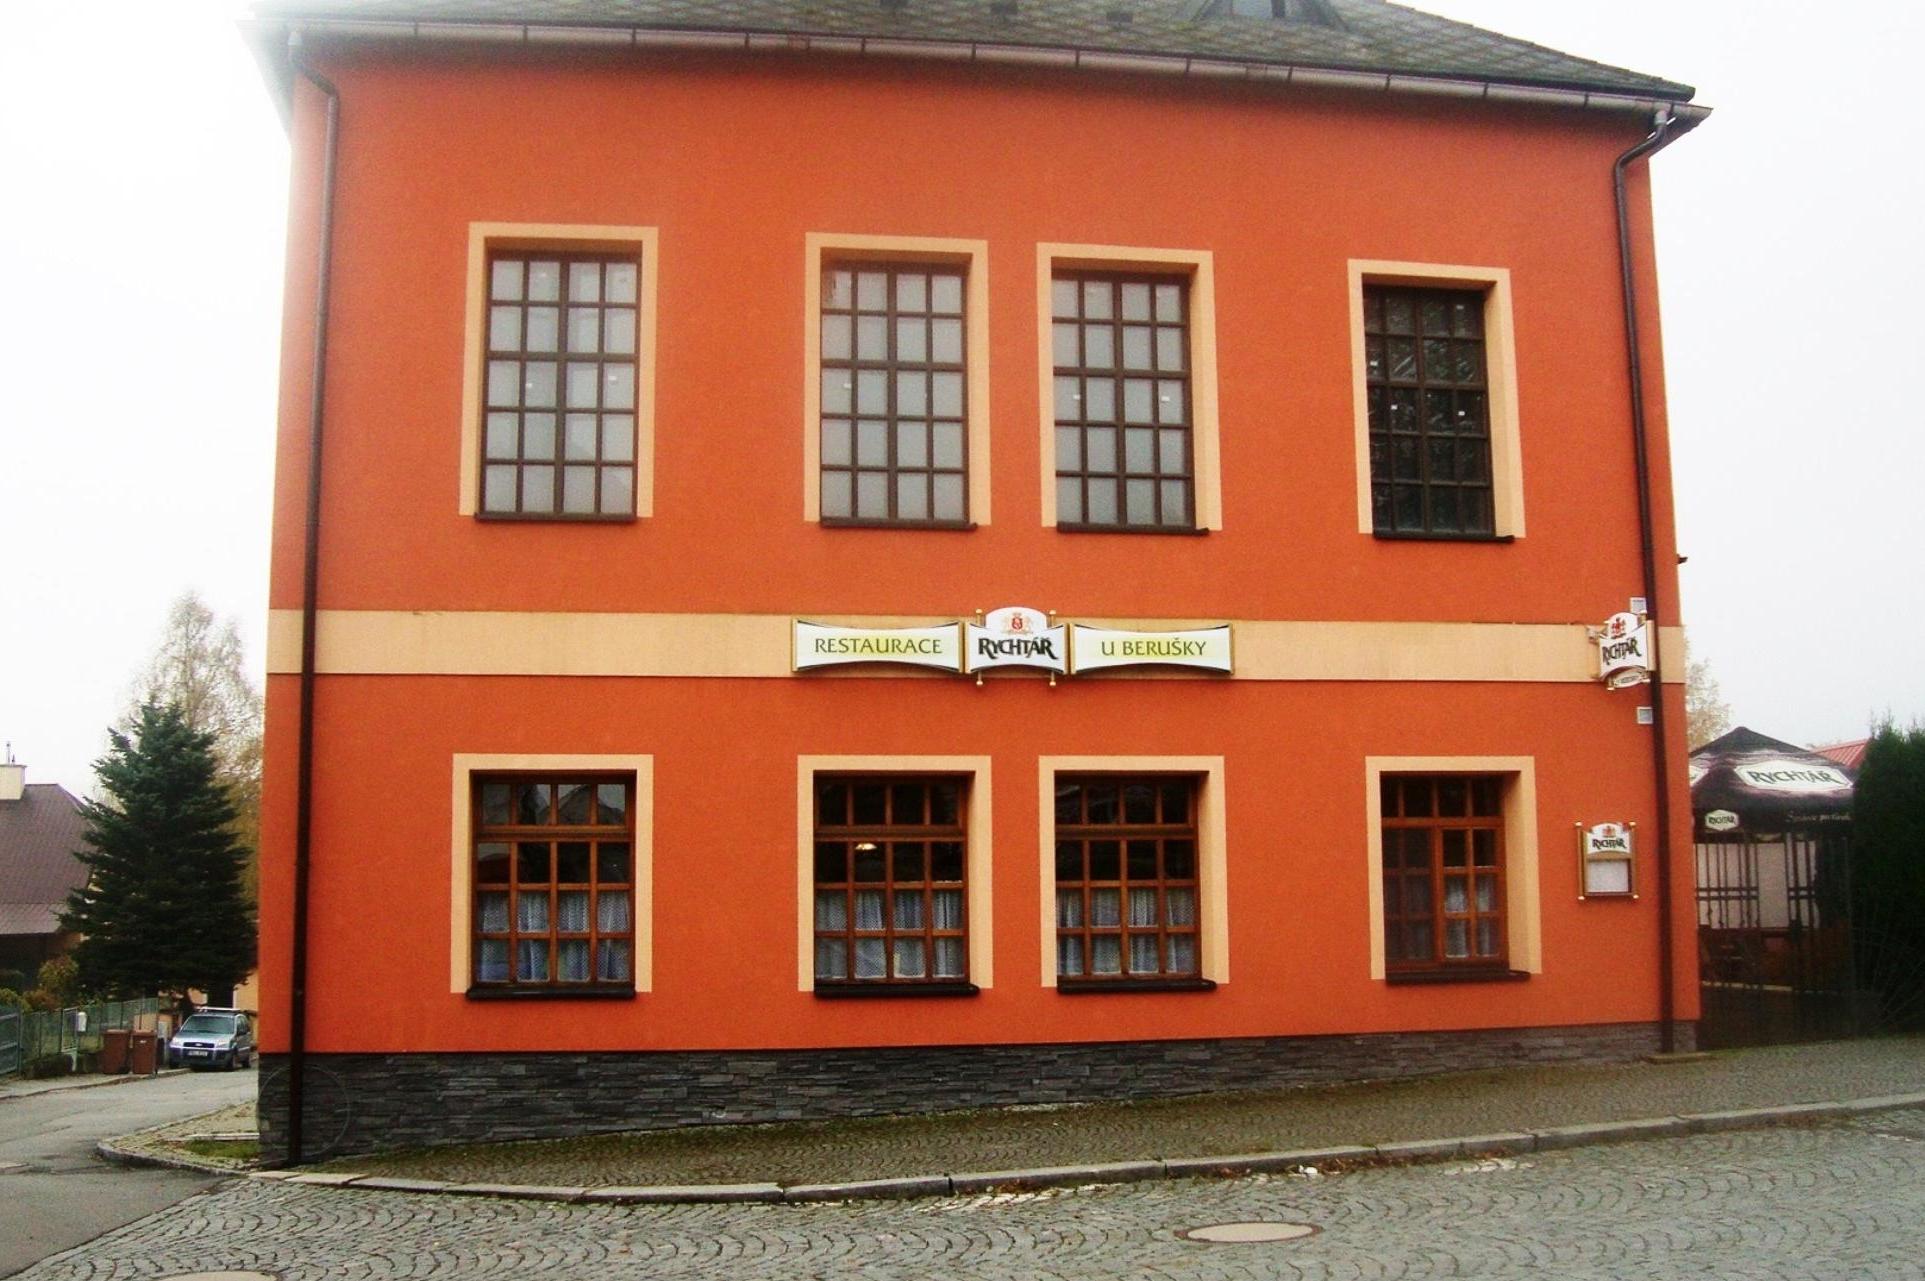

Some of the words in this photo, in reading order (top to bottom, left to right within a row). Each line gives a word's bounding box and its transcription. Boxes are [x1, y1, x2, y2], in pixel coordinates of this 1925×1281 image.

[815, 638, 943, 654] RESTAURACE
[1101, 640, 1115, 656] U
[1122, 637, 1206, 656] BERUŠKY
